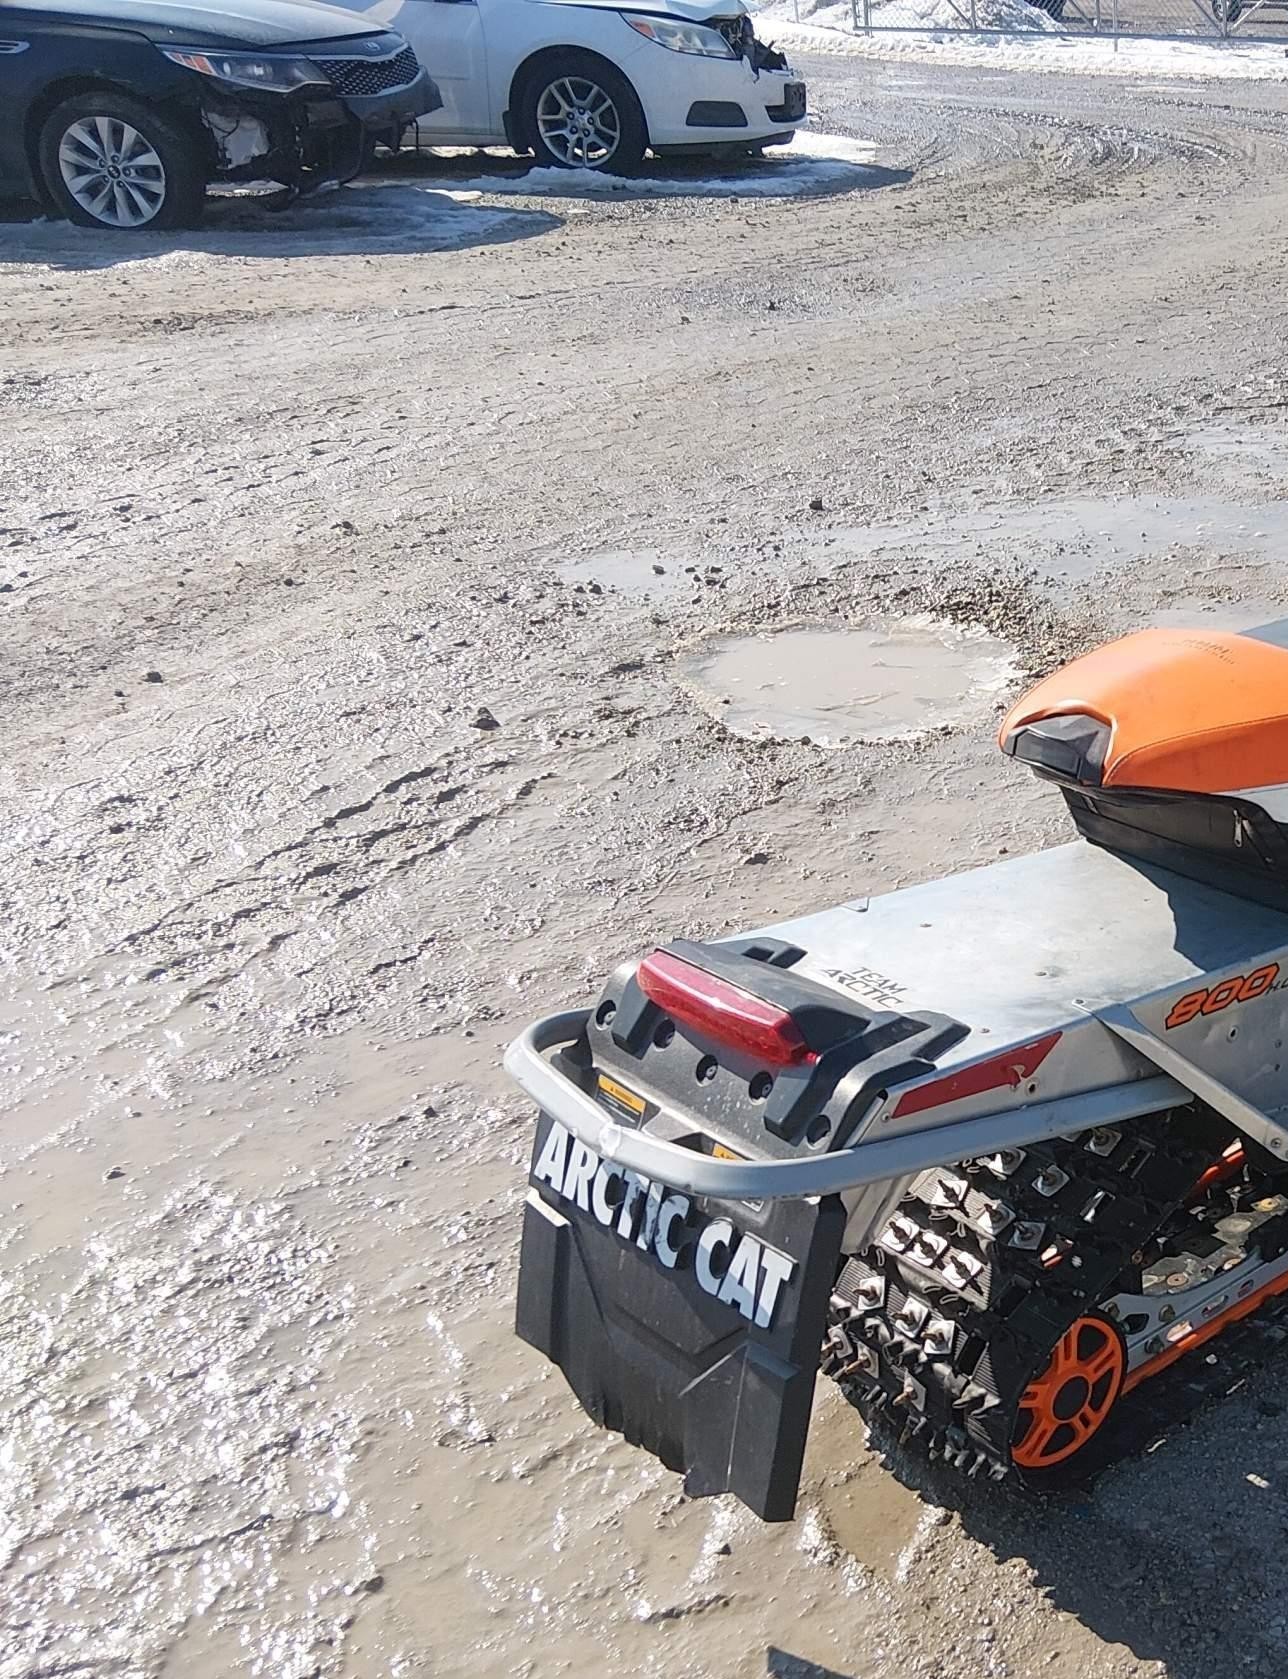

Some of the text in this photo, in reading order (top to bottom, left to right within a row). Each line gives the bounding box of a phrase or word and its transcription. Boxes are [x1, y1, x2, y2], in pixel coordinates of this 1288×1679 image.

[820, 968, 905, 1009] ARCTIC
[852, 966, 908, 995] TEAM
[1165, 961, 1280, 1031] 800
[533, 1120, 798, 1329] ARCTIC CAT
